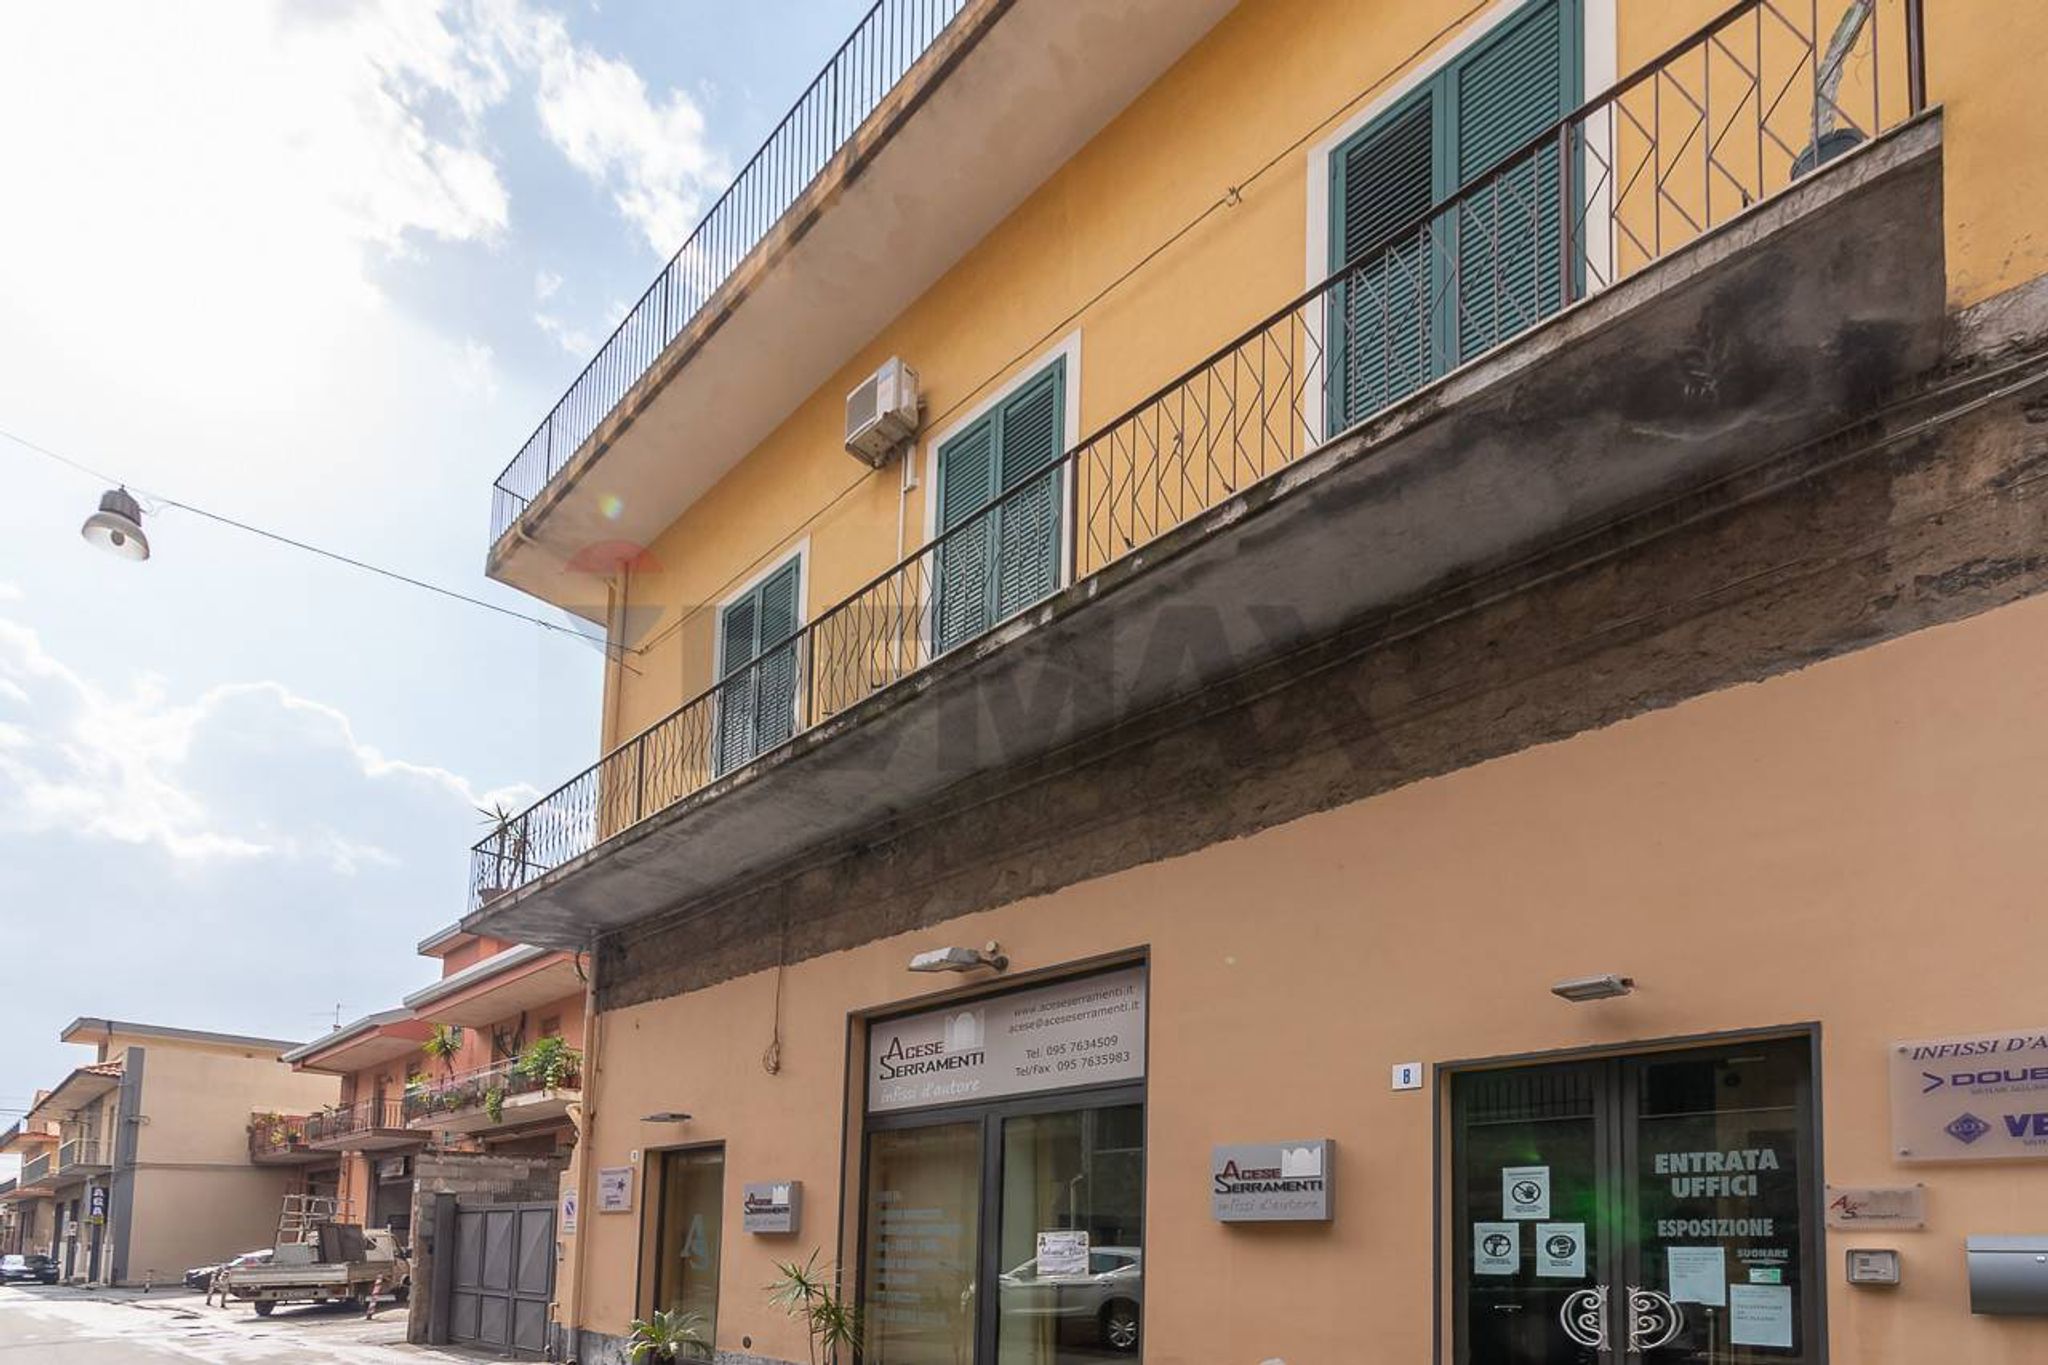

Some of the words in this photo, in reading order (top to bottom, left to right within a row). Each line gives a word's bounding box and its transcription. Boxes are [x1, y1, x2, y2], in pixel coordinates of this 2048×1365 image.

[1014, 985, 1134, 1017] www.aceseserramenti.it
[1009, 1001, 1139, 1033] acese@aceseserramenti.it
[886, 1037, 945, 1061] ACESE
[1046, 1043, 1066, 1057] 095
[1070, 1035, 1118, 1052] 7634509
[1912, 1040, 2000, 1061] INFISSI
[879, 1052, 985, 1081] SERRAMENTI
[1057, 1059, 1077, 1072] 095
[1081, 1051, 1130, 1069] 7635983
[1223, 1160, 1281, 1180] ACESE
[1655, 1149, 1780, 1174] ENTRATA
[1215, 1174, 1324, 1194] SERRAMENTI
[1671, 1175, 1758, 1198] UFFICI
[1657, 1218, 1774, 1238] ESPOSIZIONE
[1736, 1248, 1789, 1258] SUONARE
